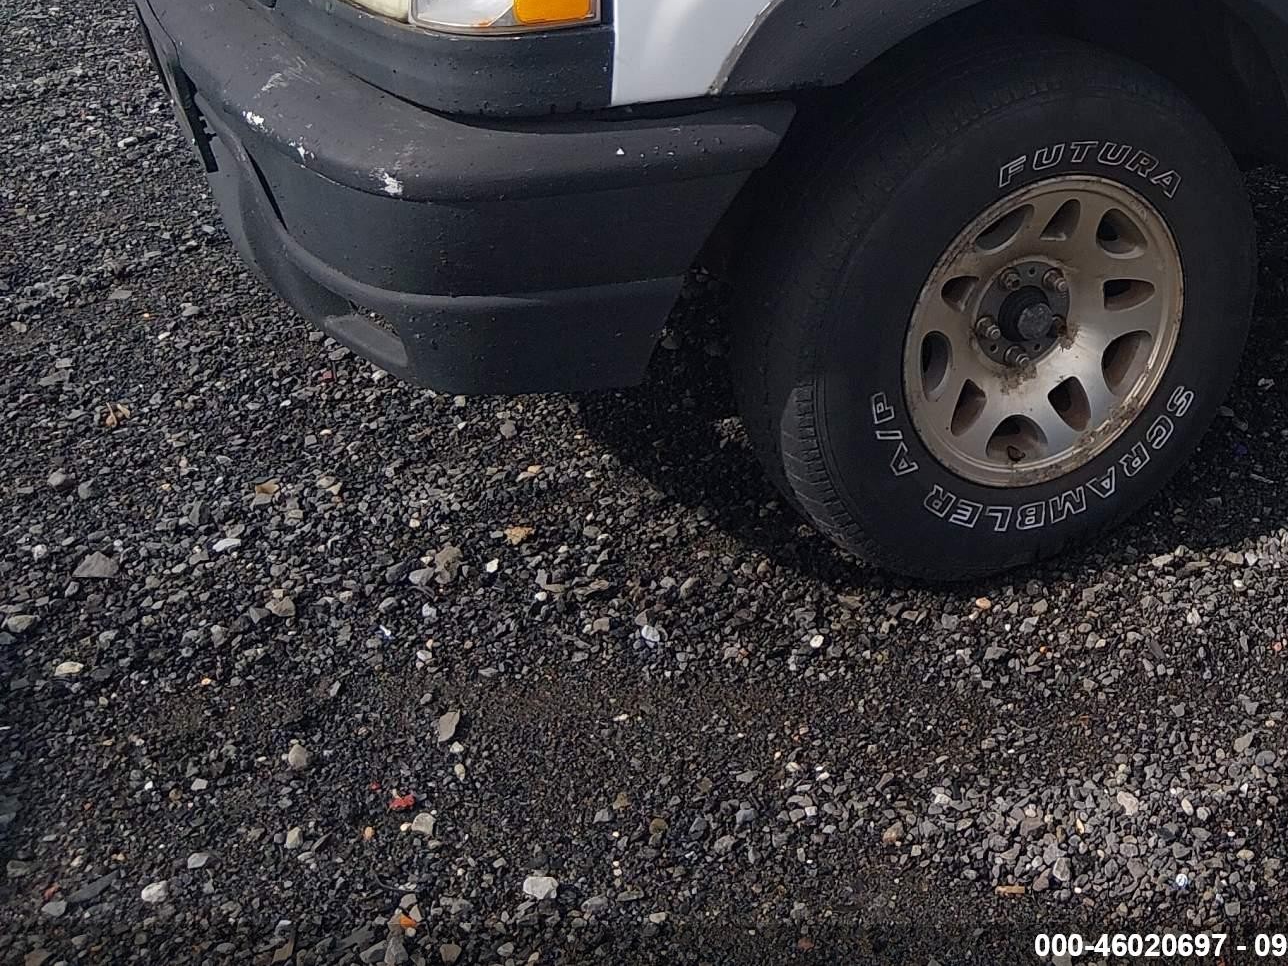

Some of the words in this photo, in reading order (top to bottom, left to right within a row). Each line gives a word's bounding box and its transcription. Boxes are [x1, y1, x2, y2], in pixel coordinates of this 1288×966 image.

[998, 140, 1183, 199] FUTURA
[870, 392, 920, 476] A/P
[923, 386, 1195, 532] SCRAMBLER
